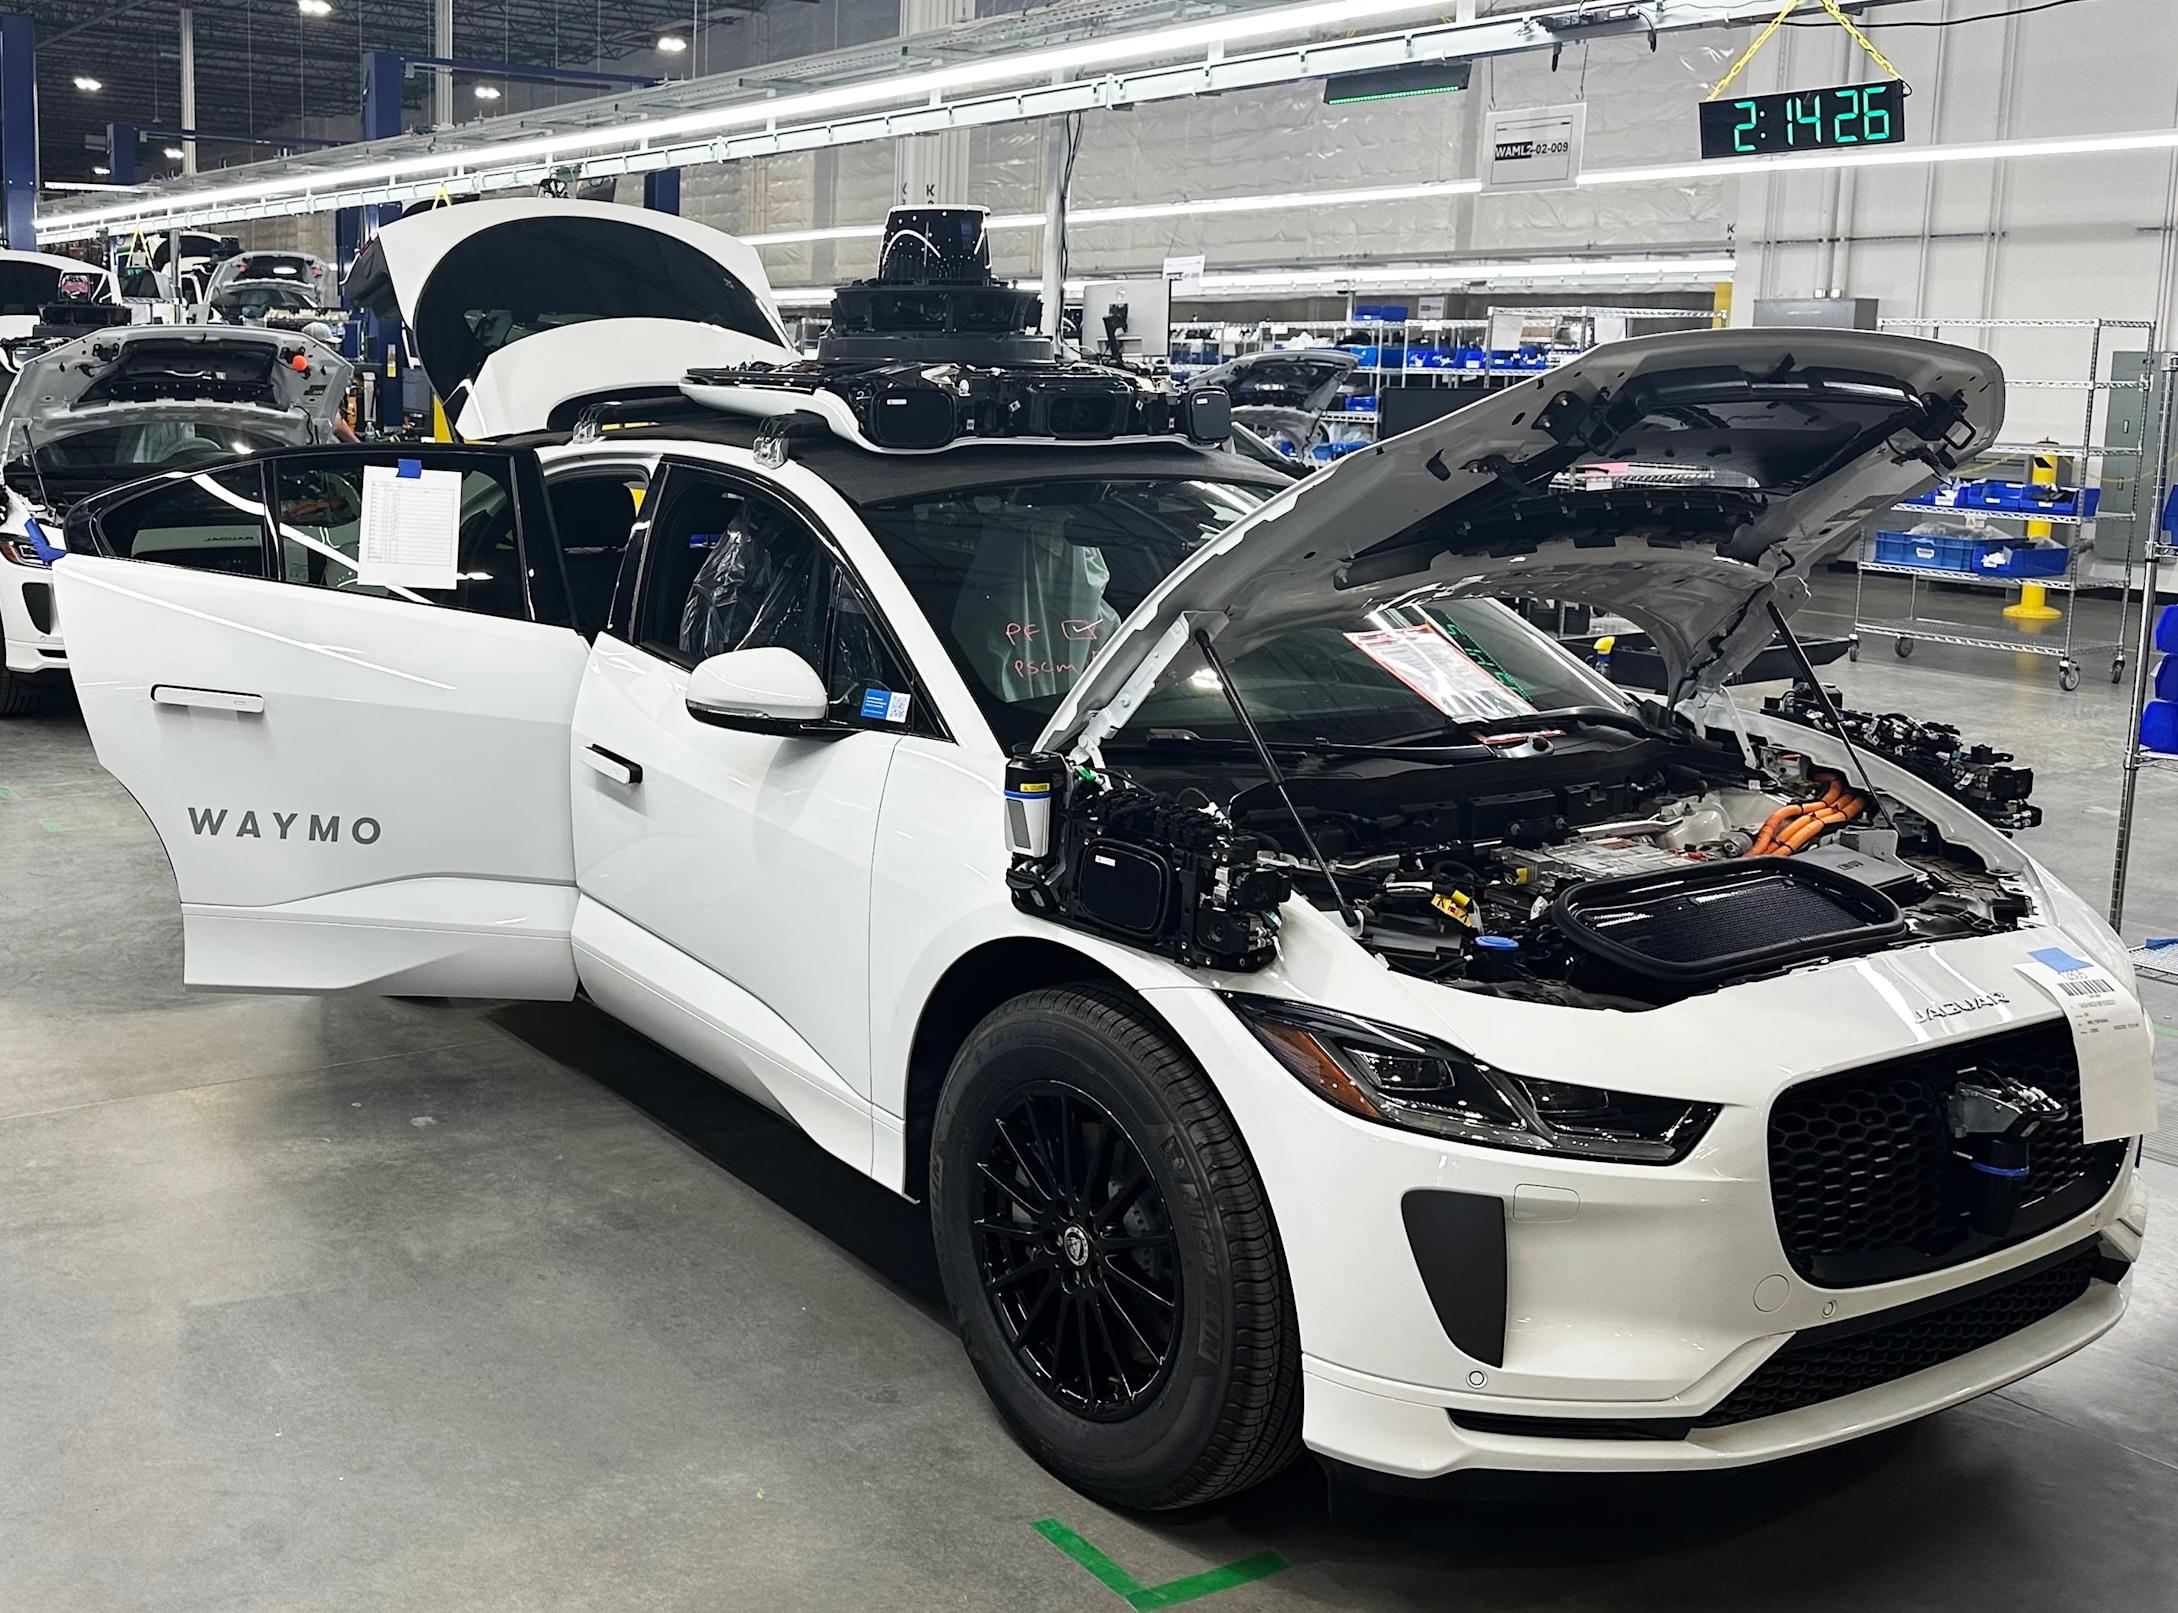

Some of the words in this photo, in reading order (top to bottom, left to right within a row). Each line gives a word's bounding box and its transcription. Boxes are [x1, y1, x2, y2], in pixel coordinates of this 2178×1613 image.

[926, 184, 935, 196] K
[1005, 622, 1040, 645] PF
[187, 807, 381, 845] WAYMO
[1915, 992, 2010, 1024] JAGUAR
